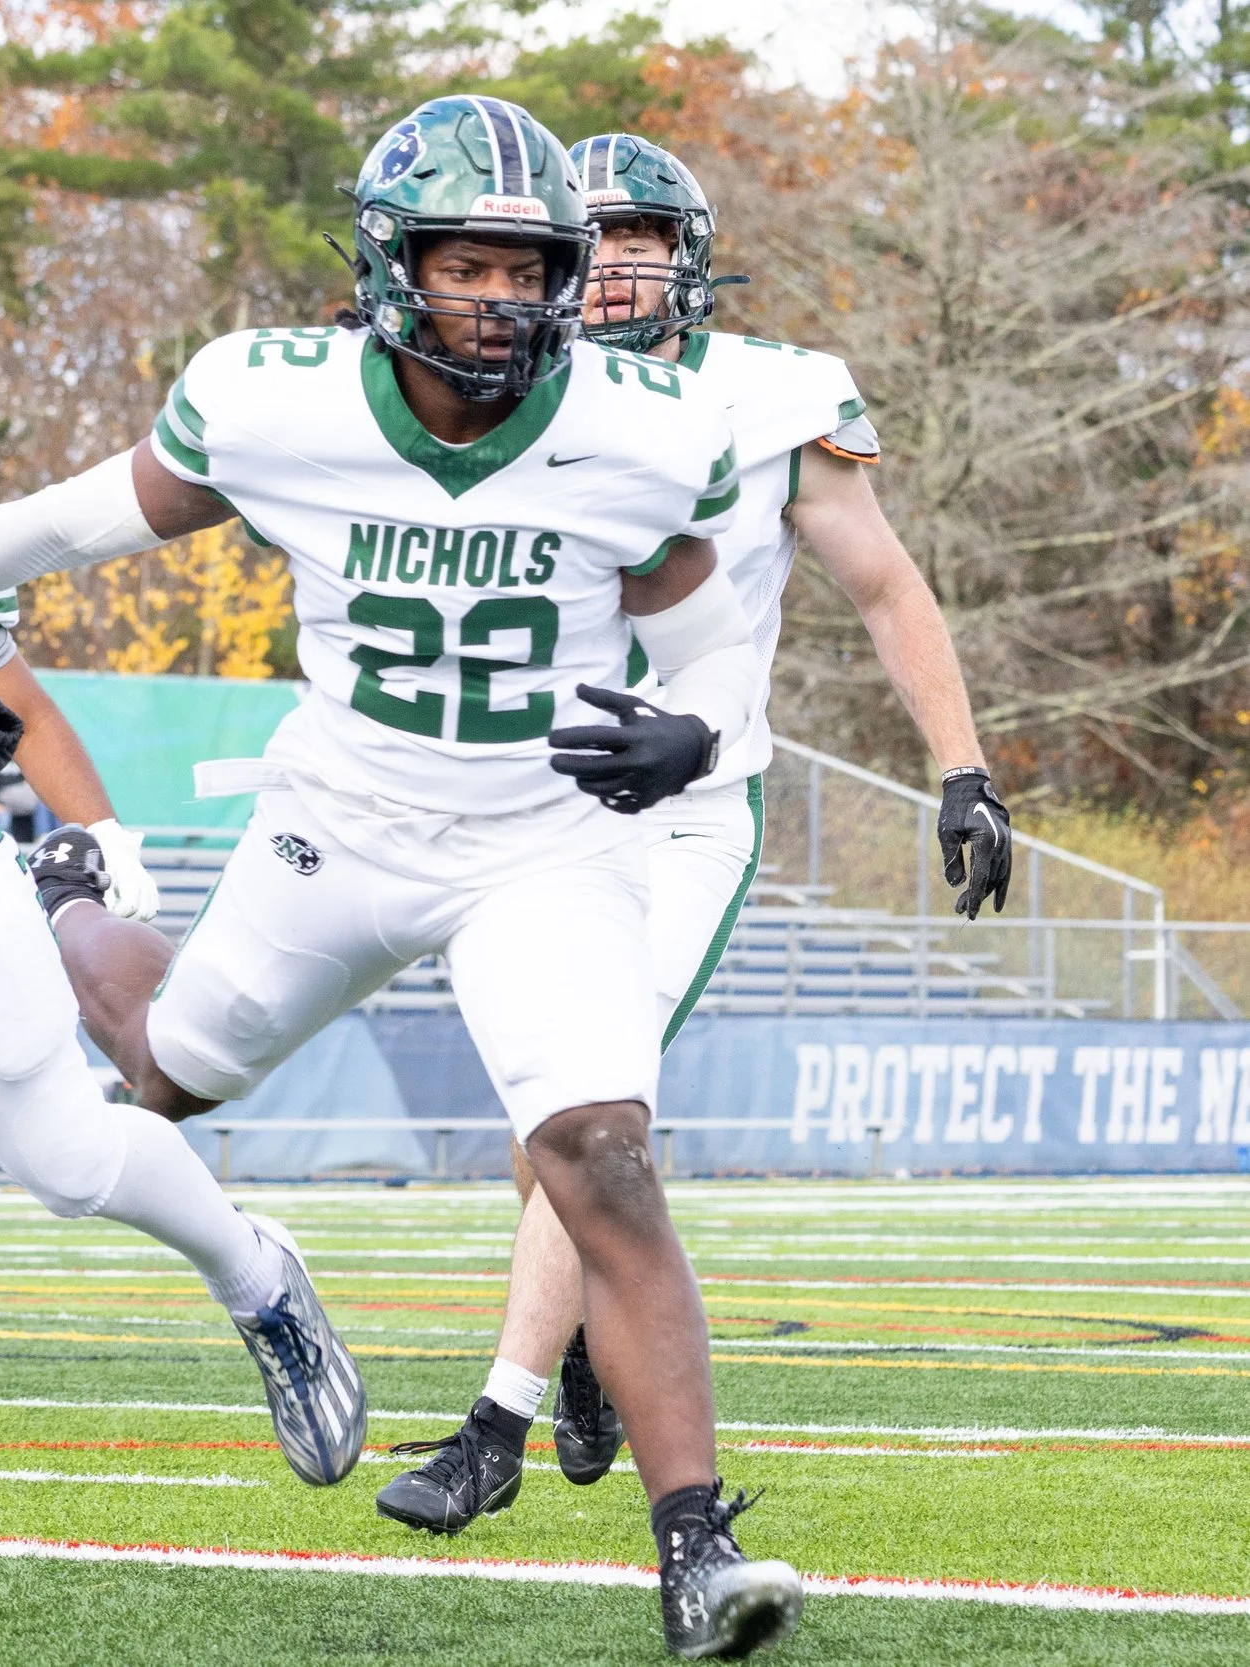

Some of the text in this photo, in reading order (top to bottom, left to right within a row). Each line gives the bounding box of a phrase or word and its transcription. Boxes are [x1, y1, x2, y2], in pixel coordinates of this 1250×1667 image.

[484, 200, 541, 216] Riddell
[344, 523, 562, 588] NICHOLS
[348, 591, 559, 744] 22
[790, 1043, 1058, 1143] PROTECT
[1072, 1046, 1183, 1144] THE
